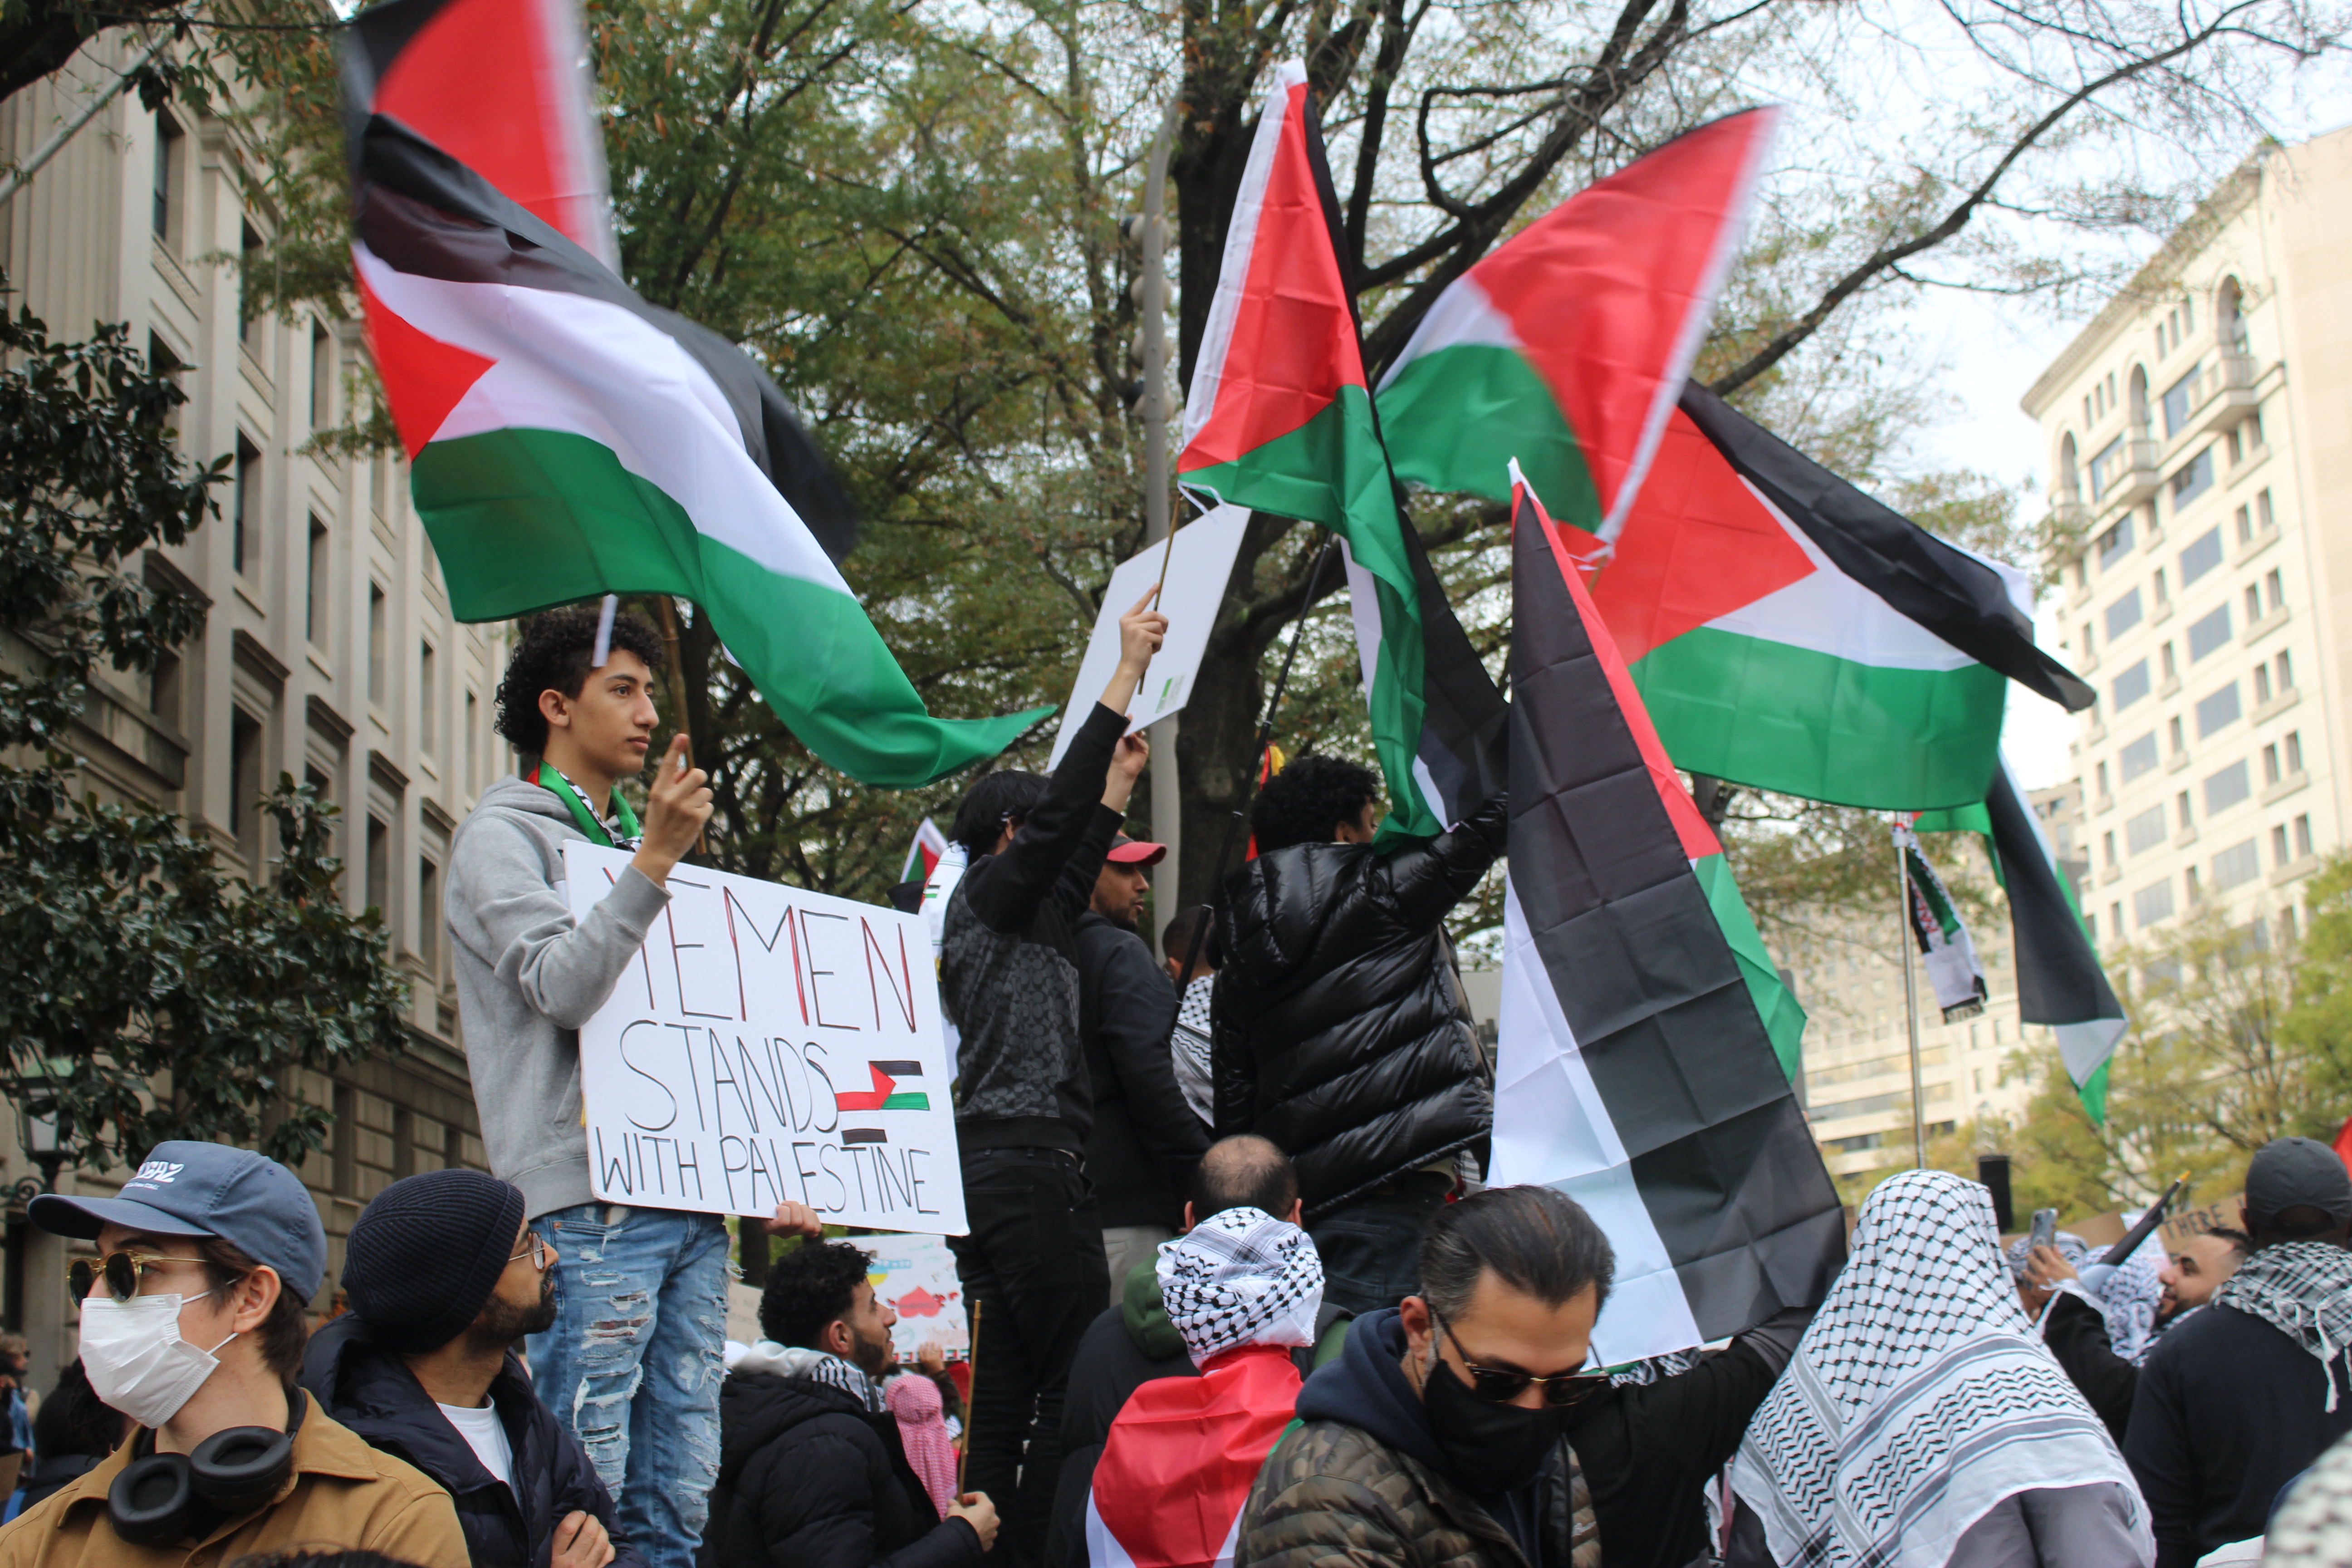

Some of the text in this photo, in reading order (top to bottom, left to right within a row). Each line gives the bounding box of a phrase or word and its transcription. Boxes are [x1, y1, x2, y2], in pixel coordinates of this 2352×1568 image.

[619, 1019, 839, 1137] STANDS
[596, 1126, 940, 1215] WITH PALESTINE
[2162, 1203, 2227, 1240] THERE
